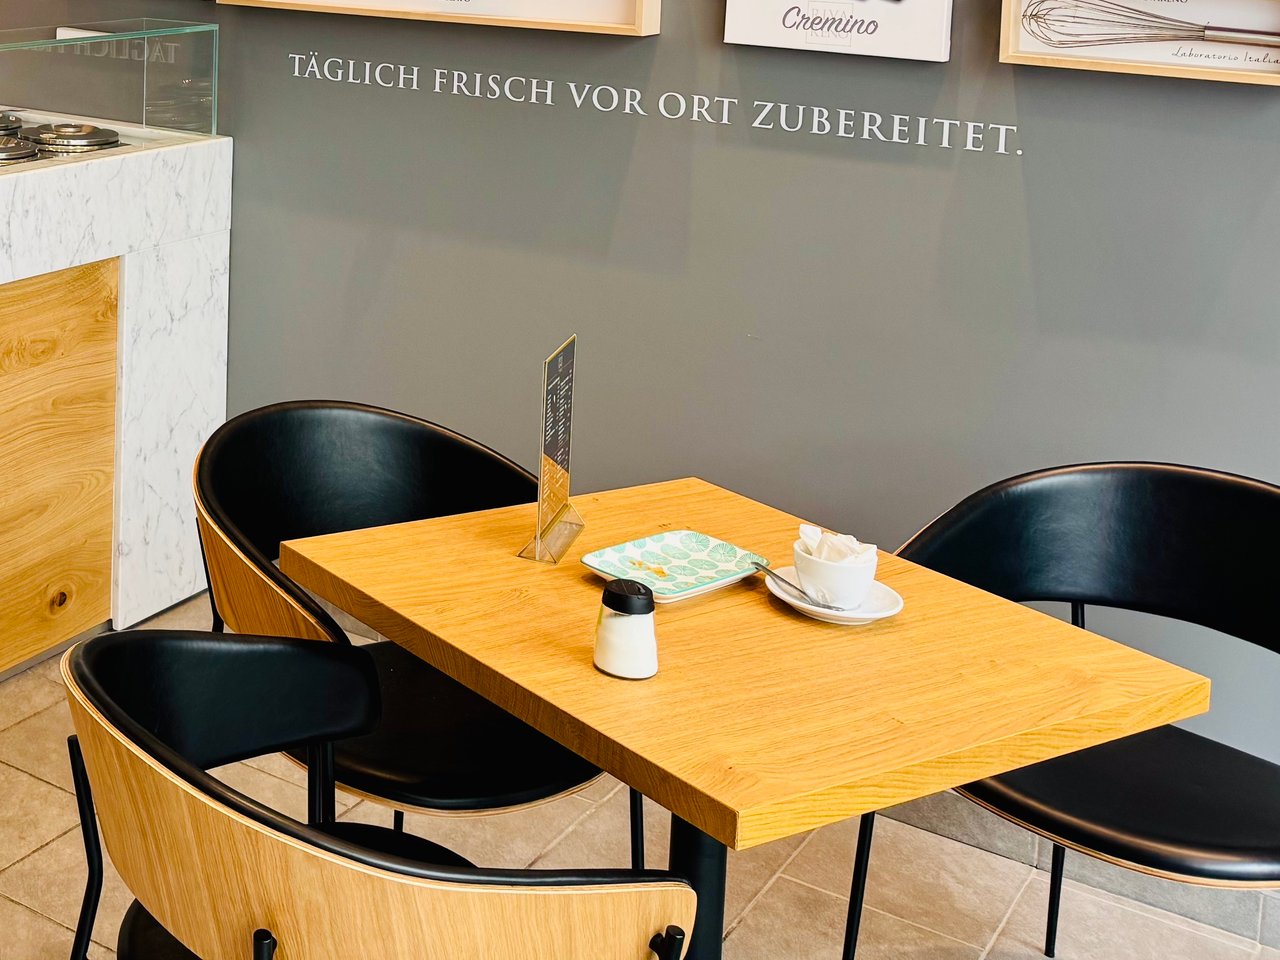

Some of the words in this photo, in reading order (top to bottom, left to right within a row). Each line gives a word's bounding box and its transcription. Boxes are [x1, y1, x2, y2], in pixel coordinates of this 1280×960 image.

[781, 6, 879, 35] Cremino
[1172, 46, 1239, 61] Laboratorio
[288, 51, 420, 90] TÄGLICH
[433, 68, 555, 106] FRISCH
[567, 82, 648, 116] VOR
[658, 91, 739, 125] ORT
[752, 99, 1024, 157] ZUBEREITET.
